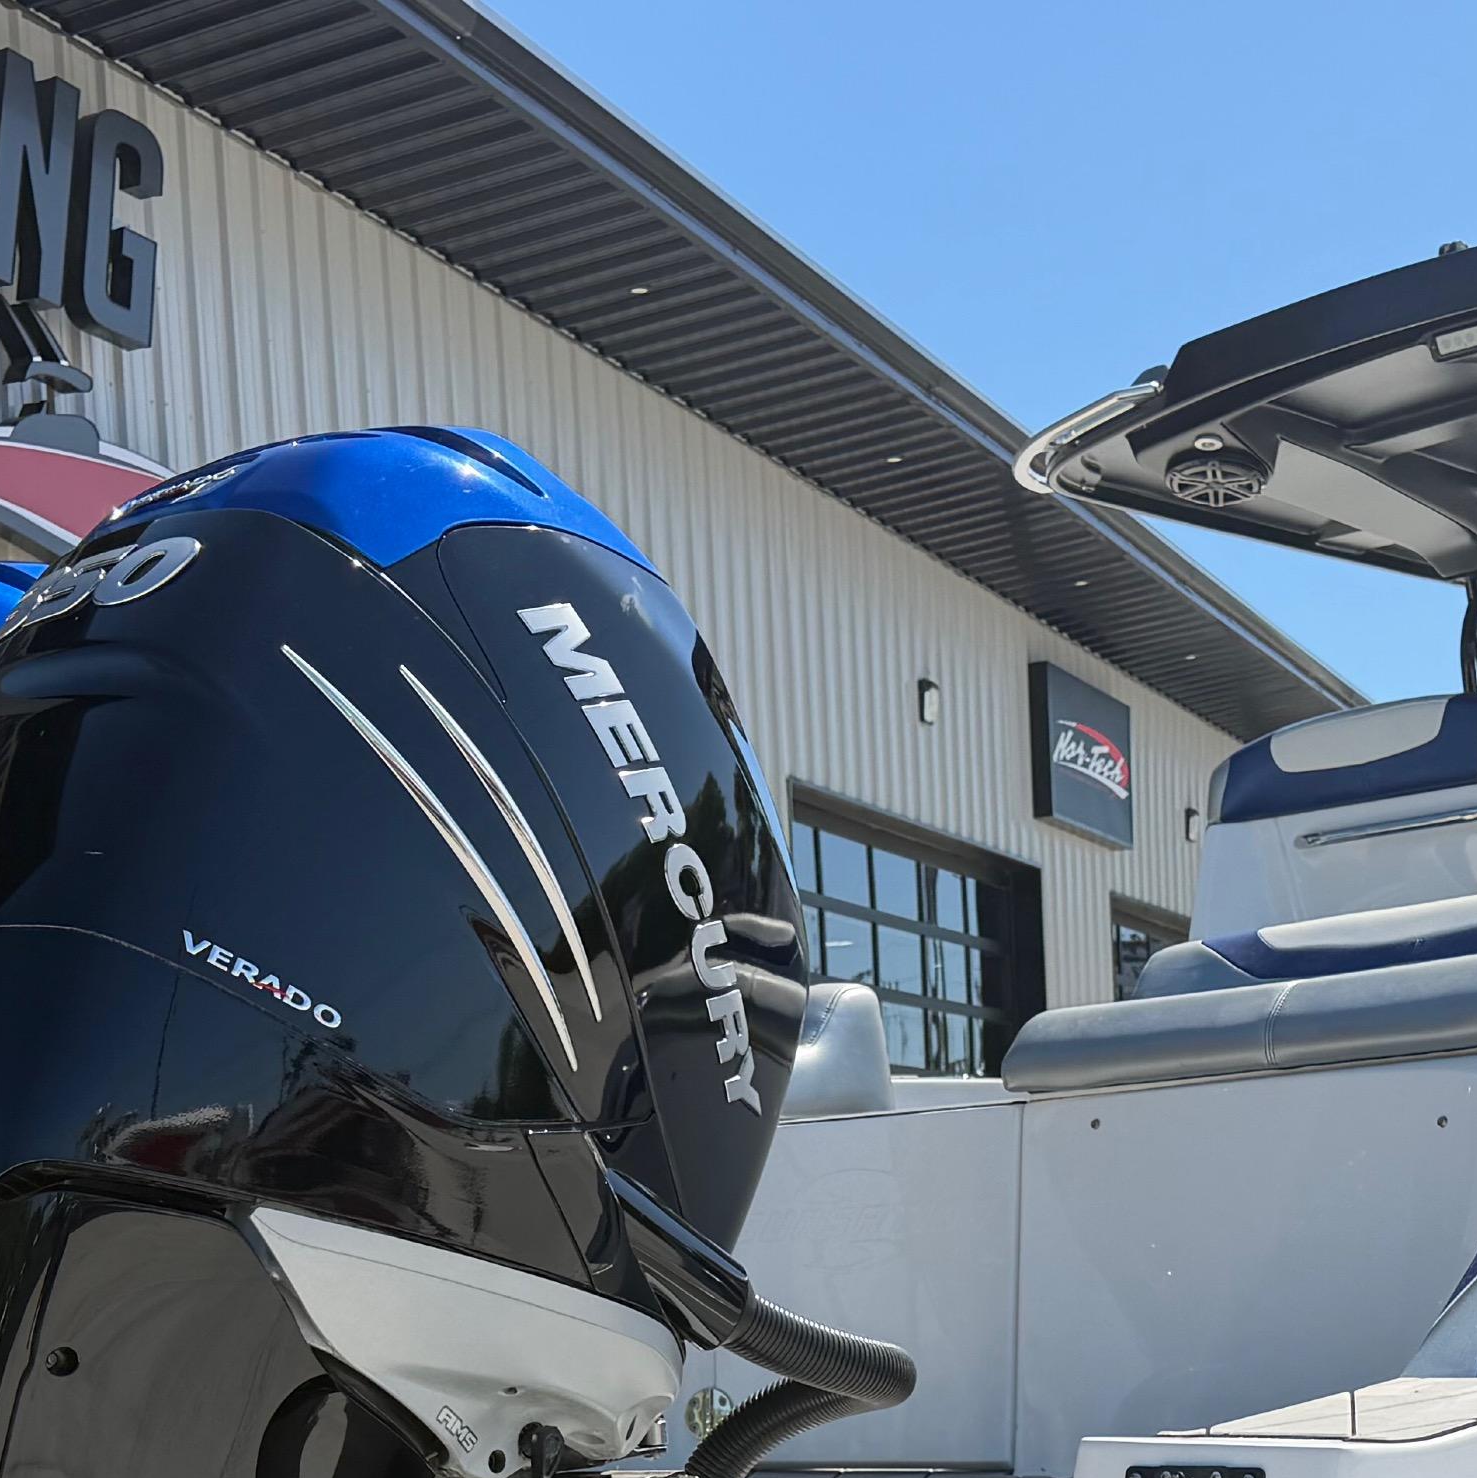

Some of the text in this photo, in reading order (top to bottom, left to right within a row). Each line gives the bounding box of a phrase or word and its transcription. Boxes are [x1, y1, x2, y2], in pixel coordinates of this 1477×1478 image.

[516, 602, 762, 1117] MERCURY
[182, 929, 342, 1029] VERADO
[436, 1405, 478, 1453] AMS
